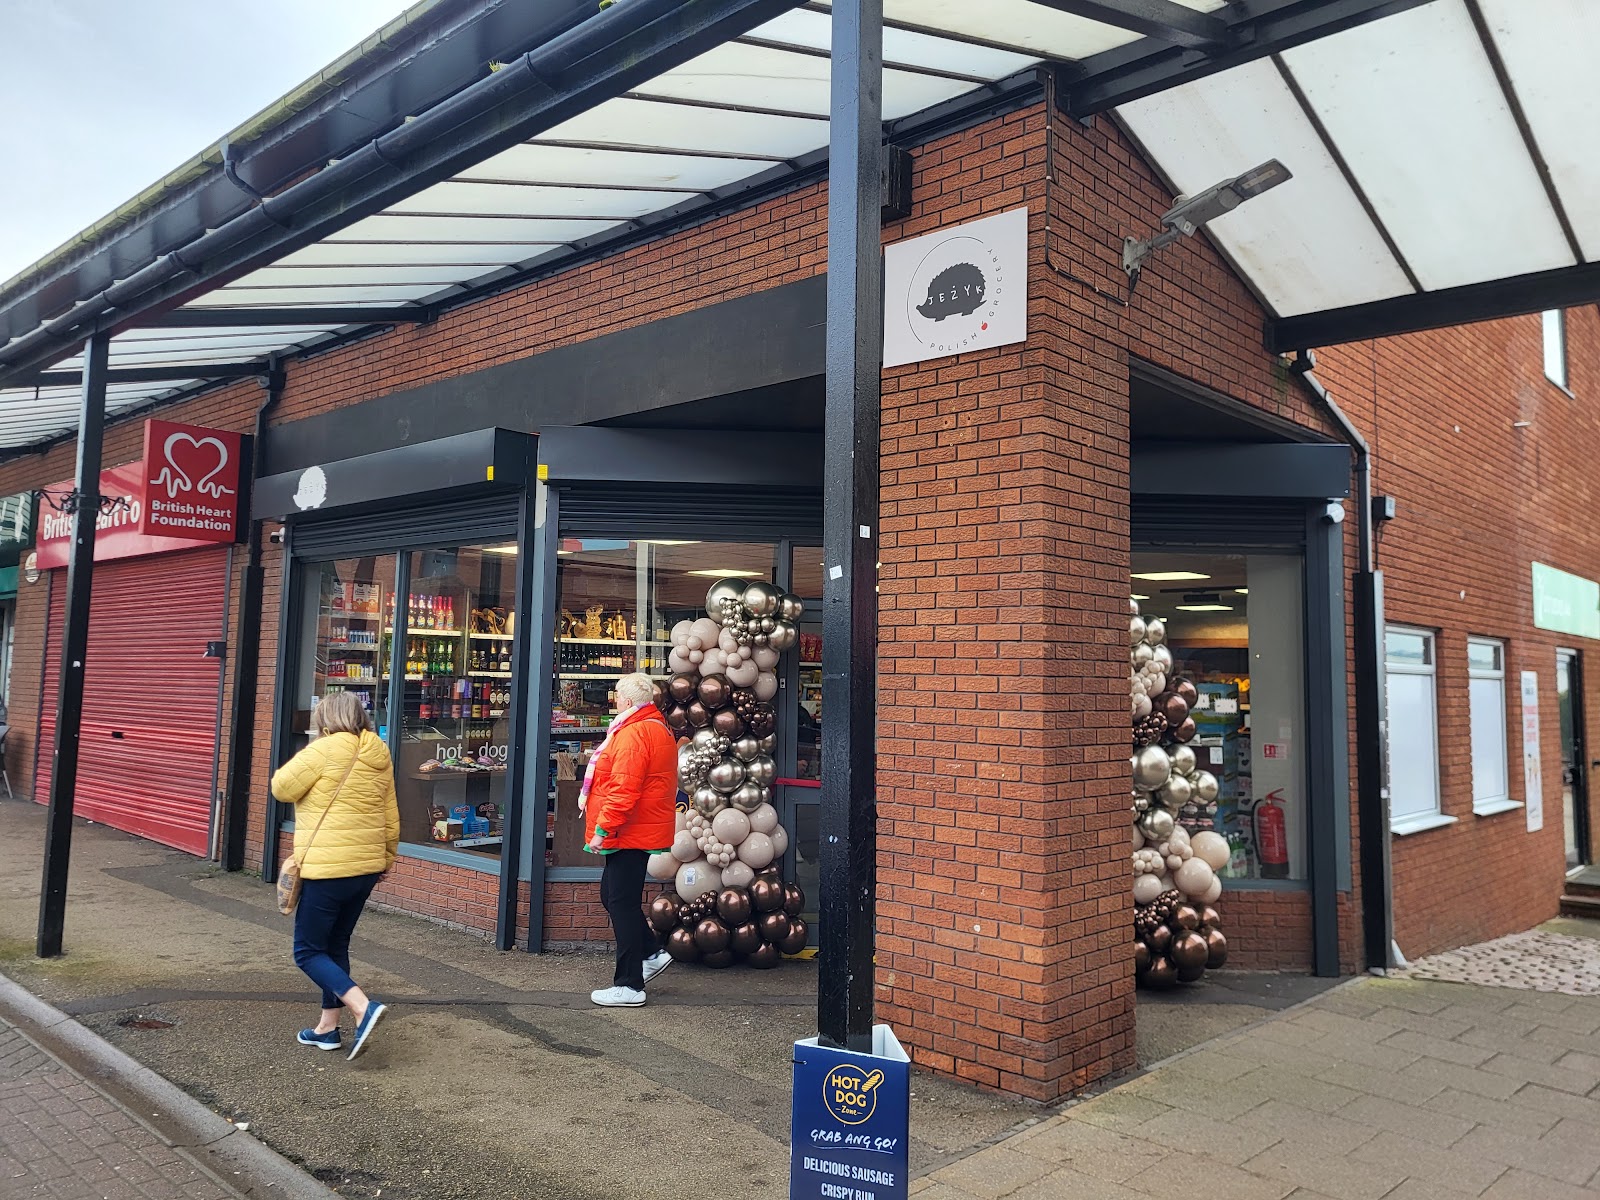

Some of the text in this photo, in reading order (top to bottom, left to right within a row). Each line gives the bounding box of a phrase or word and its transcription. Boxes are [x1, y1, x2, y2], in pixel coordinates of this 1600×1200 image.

[987, 249, 1003, 317] GROCERY
[927, 285, 983, 306] JEŻYK
[930, 332, 978, 351] POLISH
[152, 500, 195, 515] British
[196, 504, 232, 519] Heart
[43, 511, 73, 540] Britis
[150, 512, 232, 532] Foundation
[436, 743, 463, 760] hot
[478, 742, 509, 762] dog
[831, 1074, 861, 1091] HOT
[835, 1090, 867, 1108] DOG
[810, 1129, 842, 1143] GRAB
[874, 1137, 898, 1150] GO!
[803, 1157, 895, 1187] DELICIOUS SAUSAGE
[821, 1183, 854, 1200] CRISPY
